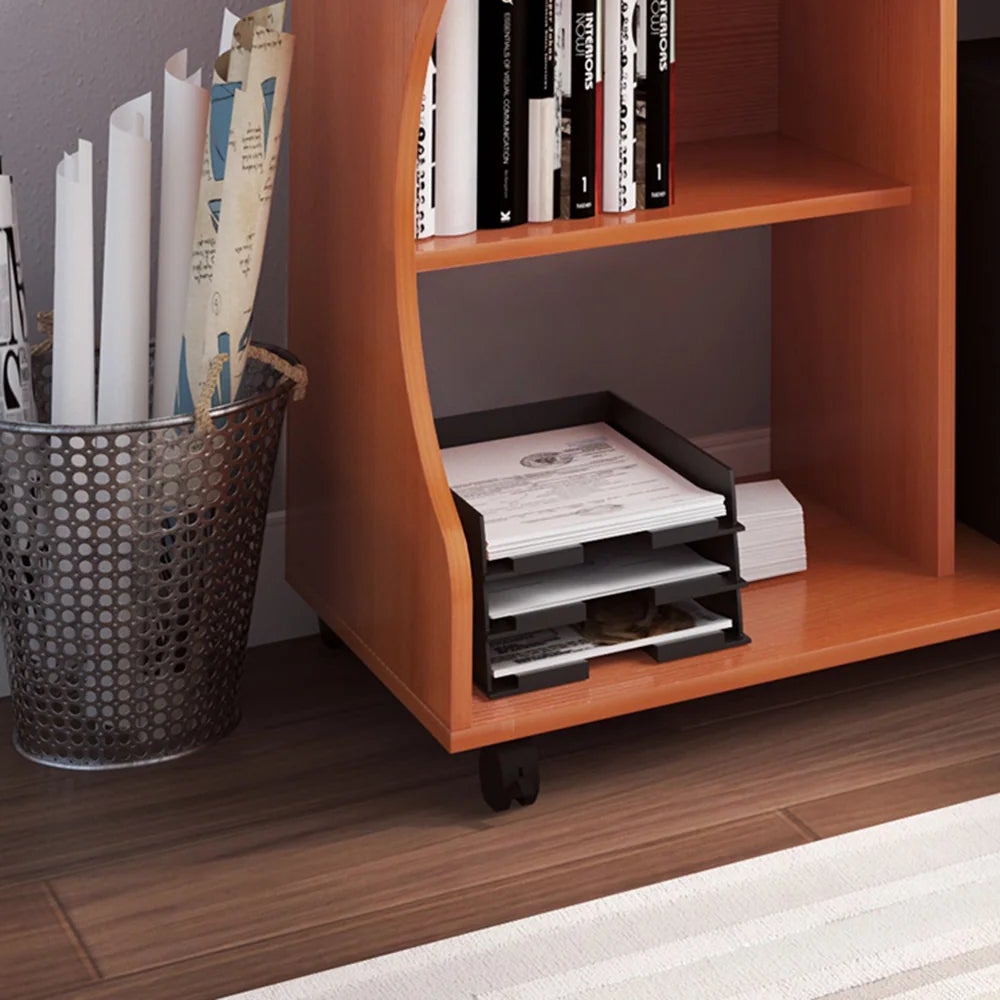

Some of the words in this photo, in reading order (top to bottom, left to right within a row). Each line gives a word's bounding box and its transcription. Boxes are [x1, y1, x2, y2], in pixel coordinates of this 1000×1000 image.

[503, 12, 511, 58] ESSENTIALS
[503, 58, 511, 69] OF
[584, 12, 594, 91] INTERIORS
[503, 70, 511, 97] VISUAL
[503, 98, 511, 165] COMMUNICATION
[581, 176, 587, 192] 1
[656, 163, 662, 180] 1
